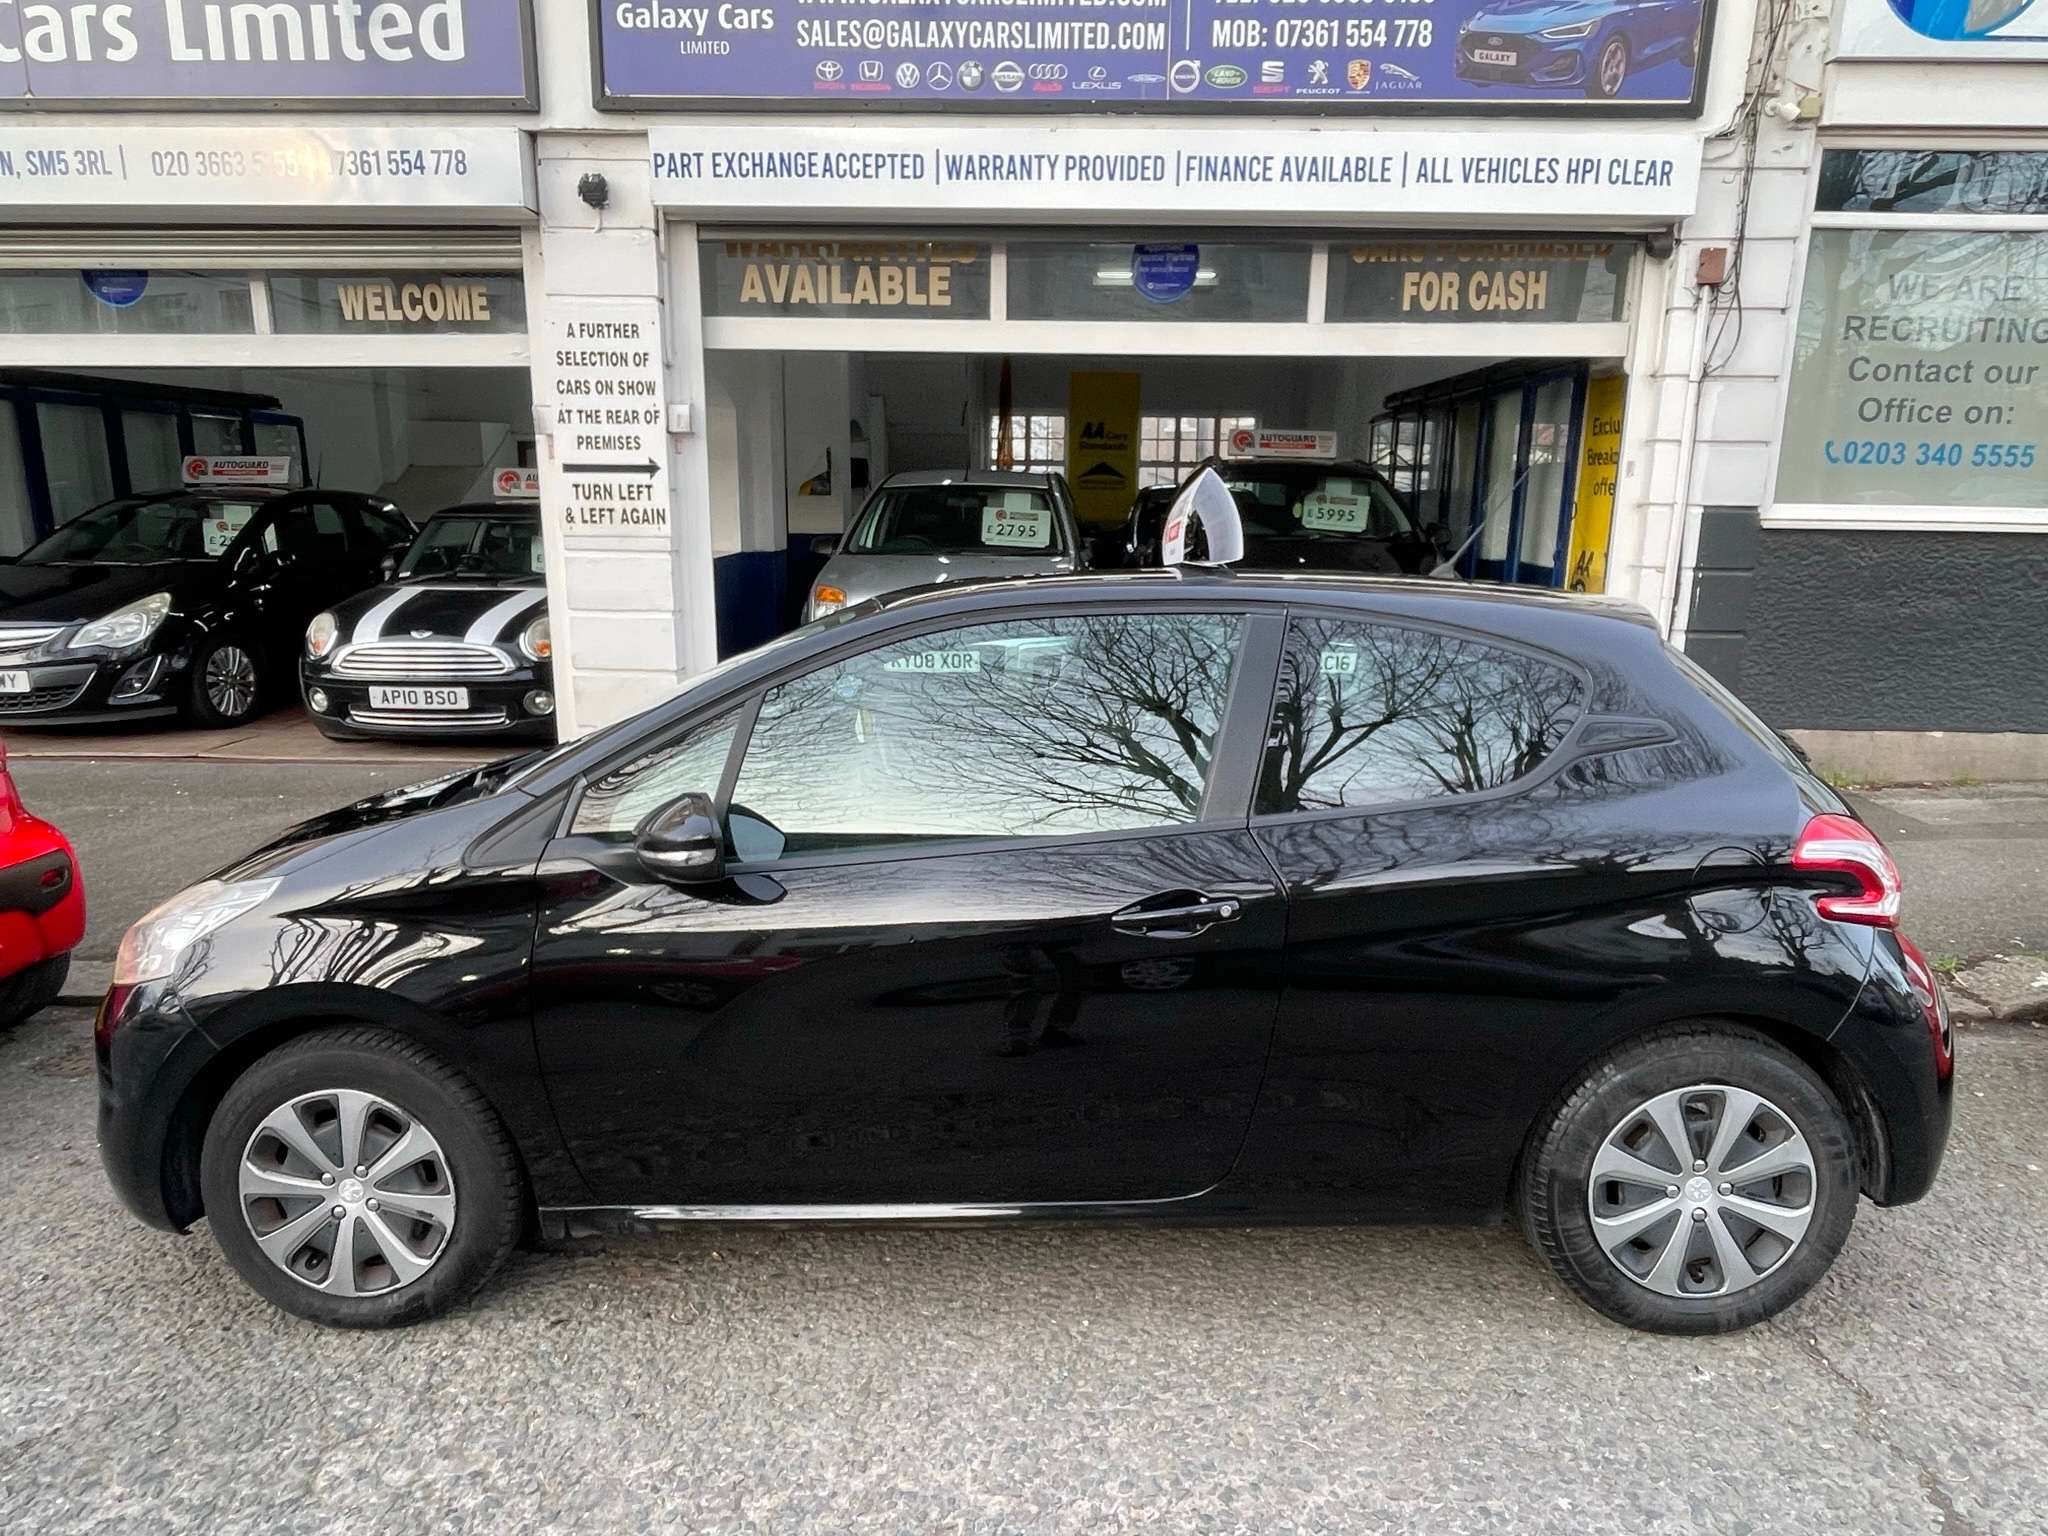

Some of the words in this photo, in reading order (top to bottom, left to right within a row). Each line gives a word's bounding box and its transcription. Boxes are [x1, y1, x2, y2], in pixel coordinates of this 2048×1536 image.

[616, 0, 709, 36] Galaxy
[718, 3, 774, 29] Cars
[164, 0, 465, 61] Limited
[796, 19, 1166, 49] SALES@GALAXYCARSLIMITED.COM
[1212, 19, 1267, 47] MOB:
[1276, 19, 1338, 47] 07361
[1346, 20, 1386, 47] 554
[1394, 20, 1432, 47] 778
[680, 41, 730, 55] LIMITED
[1072, 82, 1122, 90] LEXUS
[1376, 81, 1422, 90] JAGUAR
[25, 150, 69, 176] SM5
[74, 150, 112, 176] 3RL
[151, 151, 189, 176] 020
[195, 151, 245, 176] 3663
[387, 150, 426, 176] 554
[430, 149, 467, 176] 778
[654, 152, 704, 178] PART
[712, 152, 819, 178] EXCHANGE
[822, 153, 924, 179] ACCEPTED
[945, 154, 1059, 181] WARRANTY
[1065, 155, 1165, 181] PROVIDED
[1186, 155, 1274, 182] FINANCE
[1280, 156, 1393, 183] AVAILABLE
[1416, 157, 1453, 183] ALL
[1461, 157, 1559, 184] VEHICLES
[1566, 158, 1601, 184] HPI
[1608, 158, 1673, 186] CLEAR
[740, 264, 951, 305] AVAILABLE
[1402, 271, 1460, 311] FOR
[1468, 270, 1548, 311] CASH
[1889, 274, 1942, 300] WE
[1953, 275, 2023, 300] ARE
[337, 283, 491, 322] WELCOME
[567, 323, 575, 338] A
[579, 323, 640, 339] FURTHER
[556, 351, 628, 367] SELECTION
[633, 352, 649, 368] OF
[1848, 356, 1974, 383] Contact
[1984, 365, 2039, 384] our
[556, 380, 590, 395] CARS
[595, 380, 613, 395] ON
[618, 381, 656, 396] SHOW
[558, 409, 573, 424] AT
[577, 410, 601, 424] THE
[606, 410, 639, 424] REAR
[644, 410, 660, 424] OF
[1858, 397, 1952, 423] Office
[1965, 405, 2015, 424] on:
[577, 436, 641, 450] PREMISES
[1260, 434, 1317, 442] AUTOGUARD
[1844, 441, 1906, 465] 0203
[1916, 443, 1963, 466] 340
[1971, 444, 2037, 468] 5555
[572, 484, 612, 500] TURN
[618, 485, 653, 500] LEFT
[565, 508, 575, 524] &
[581, 508, 614, 524] LEFT
[621, 508, 666, 524] AGAIN
[941, 654, 973, 668] XOR
[382, 690, 418, 704] AP10
